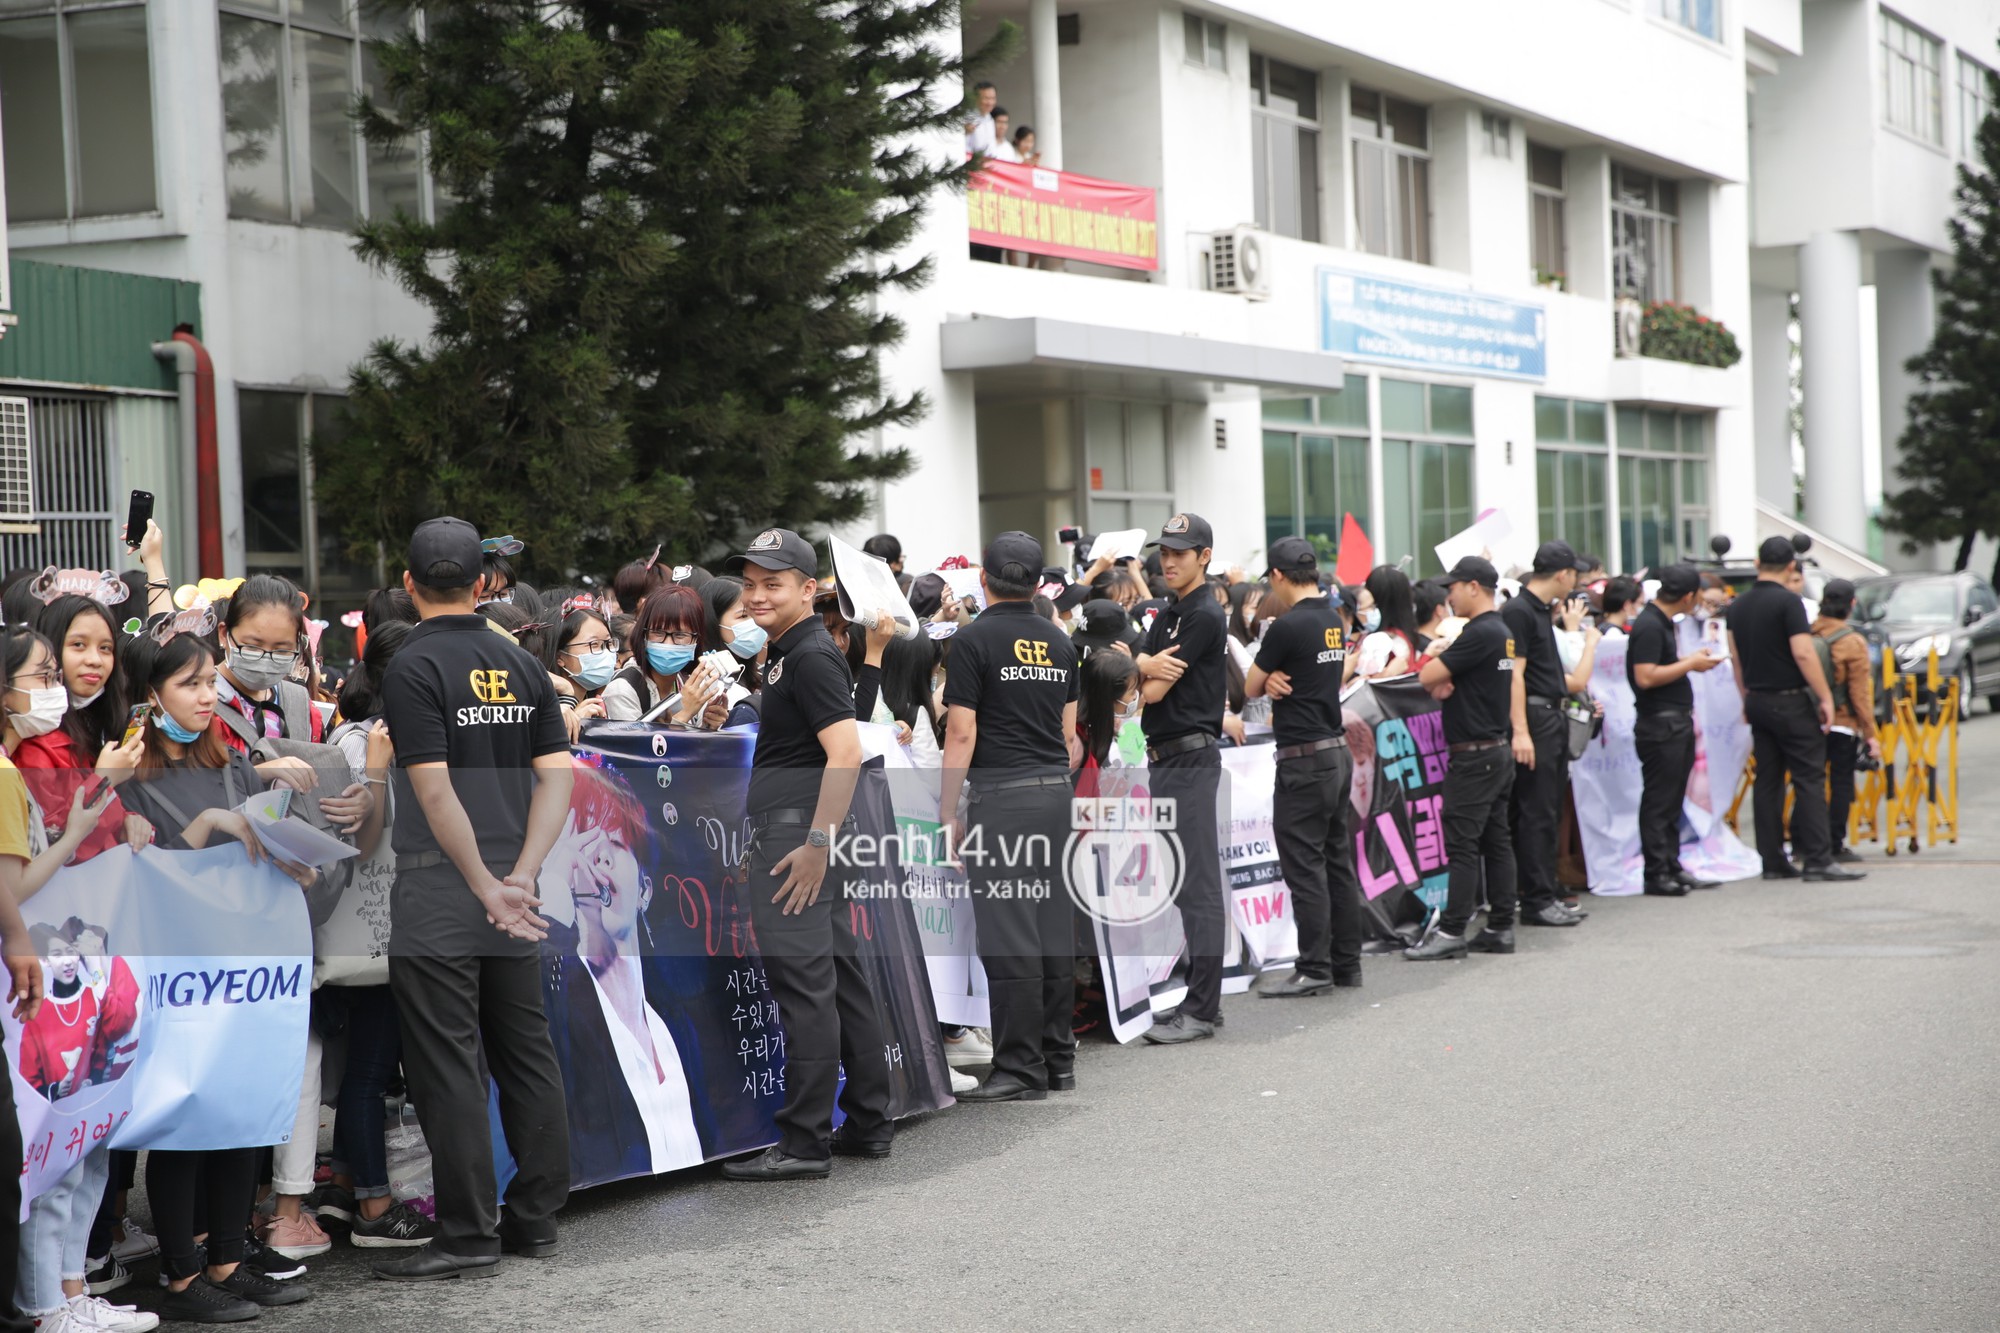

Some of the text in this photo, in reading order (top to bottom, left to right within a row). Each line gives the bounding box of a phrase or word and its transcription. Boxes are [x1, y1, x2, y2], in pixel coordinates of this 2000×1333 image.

[60, 576, 97, 592] MARK
[174, 616, 200, 629] MARK
[1325, 628, 1342, 649] GE
[1014, 639, 1053, 666] GE
[1000, 666, 1068, 683] SECURITY
[470, 669, 516, 703] GE
[456, 705, 536, 727] SECURITY
[1246, 841, 1271, 857] YOU
[732, 1000, 780, 1032] 수있게
[738, 1031, 785, 1066] 우리가
